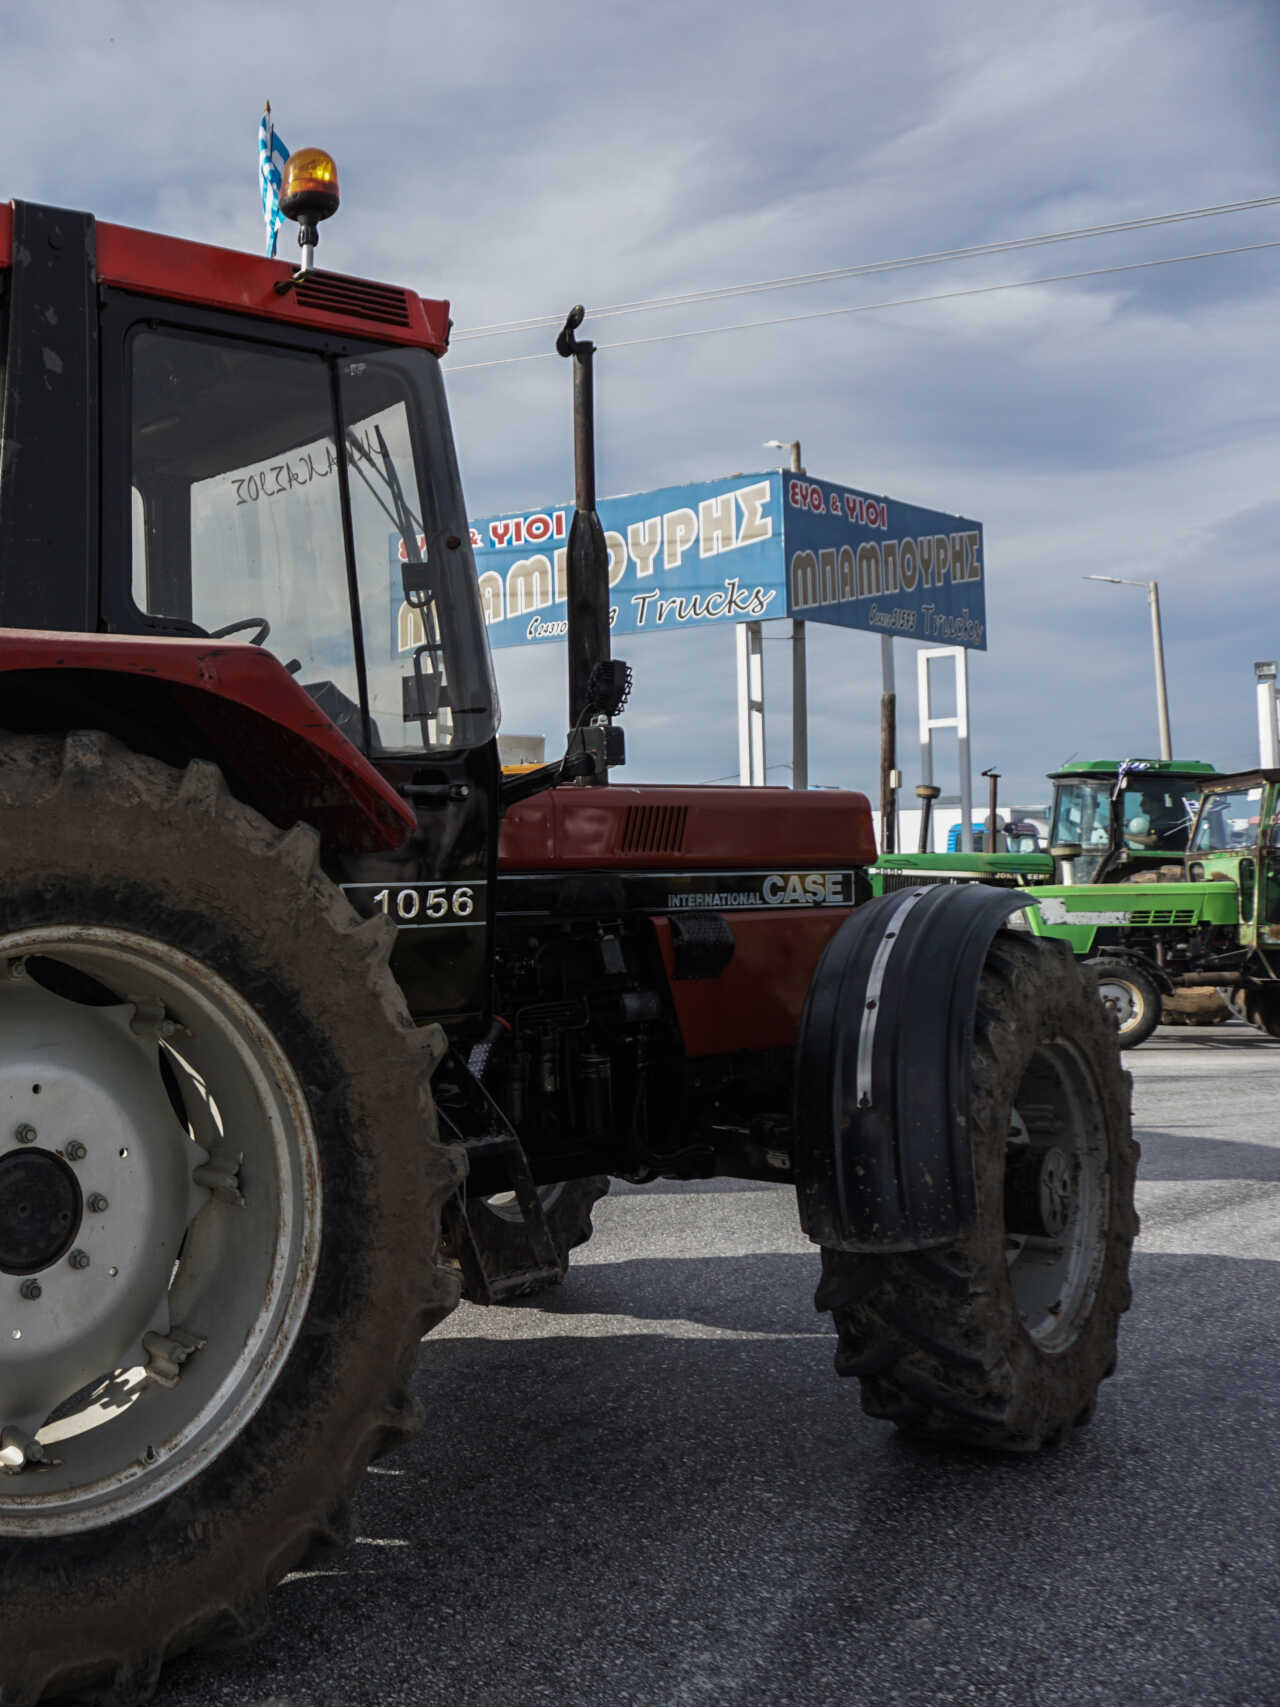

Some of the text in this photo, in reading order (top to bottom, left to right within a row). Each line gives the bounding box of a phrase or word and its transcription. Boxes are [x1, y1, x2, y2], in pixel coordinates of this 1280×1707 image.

[490, 511, 567, 548] ΥΙΟΙ
[830, 493, 842, 515] &
[844, 493, 888, 530] ΥΙΟΙ
[791, 530, 981, 611] ΜΠΑΜΠΟΥΡΗΣ
[632, 577, 776, 626] Trucks
[373, 887, 474, 919] 1056
[668, 874, 842, 907] INTERNATIONAL CASE
